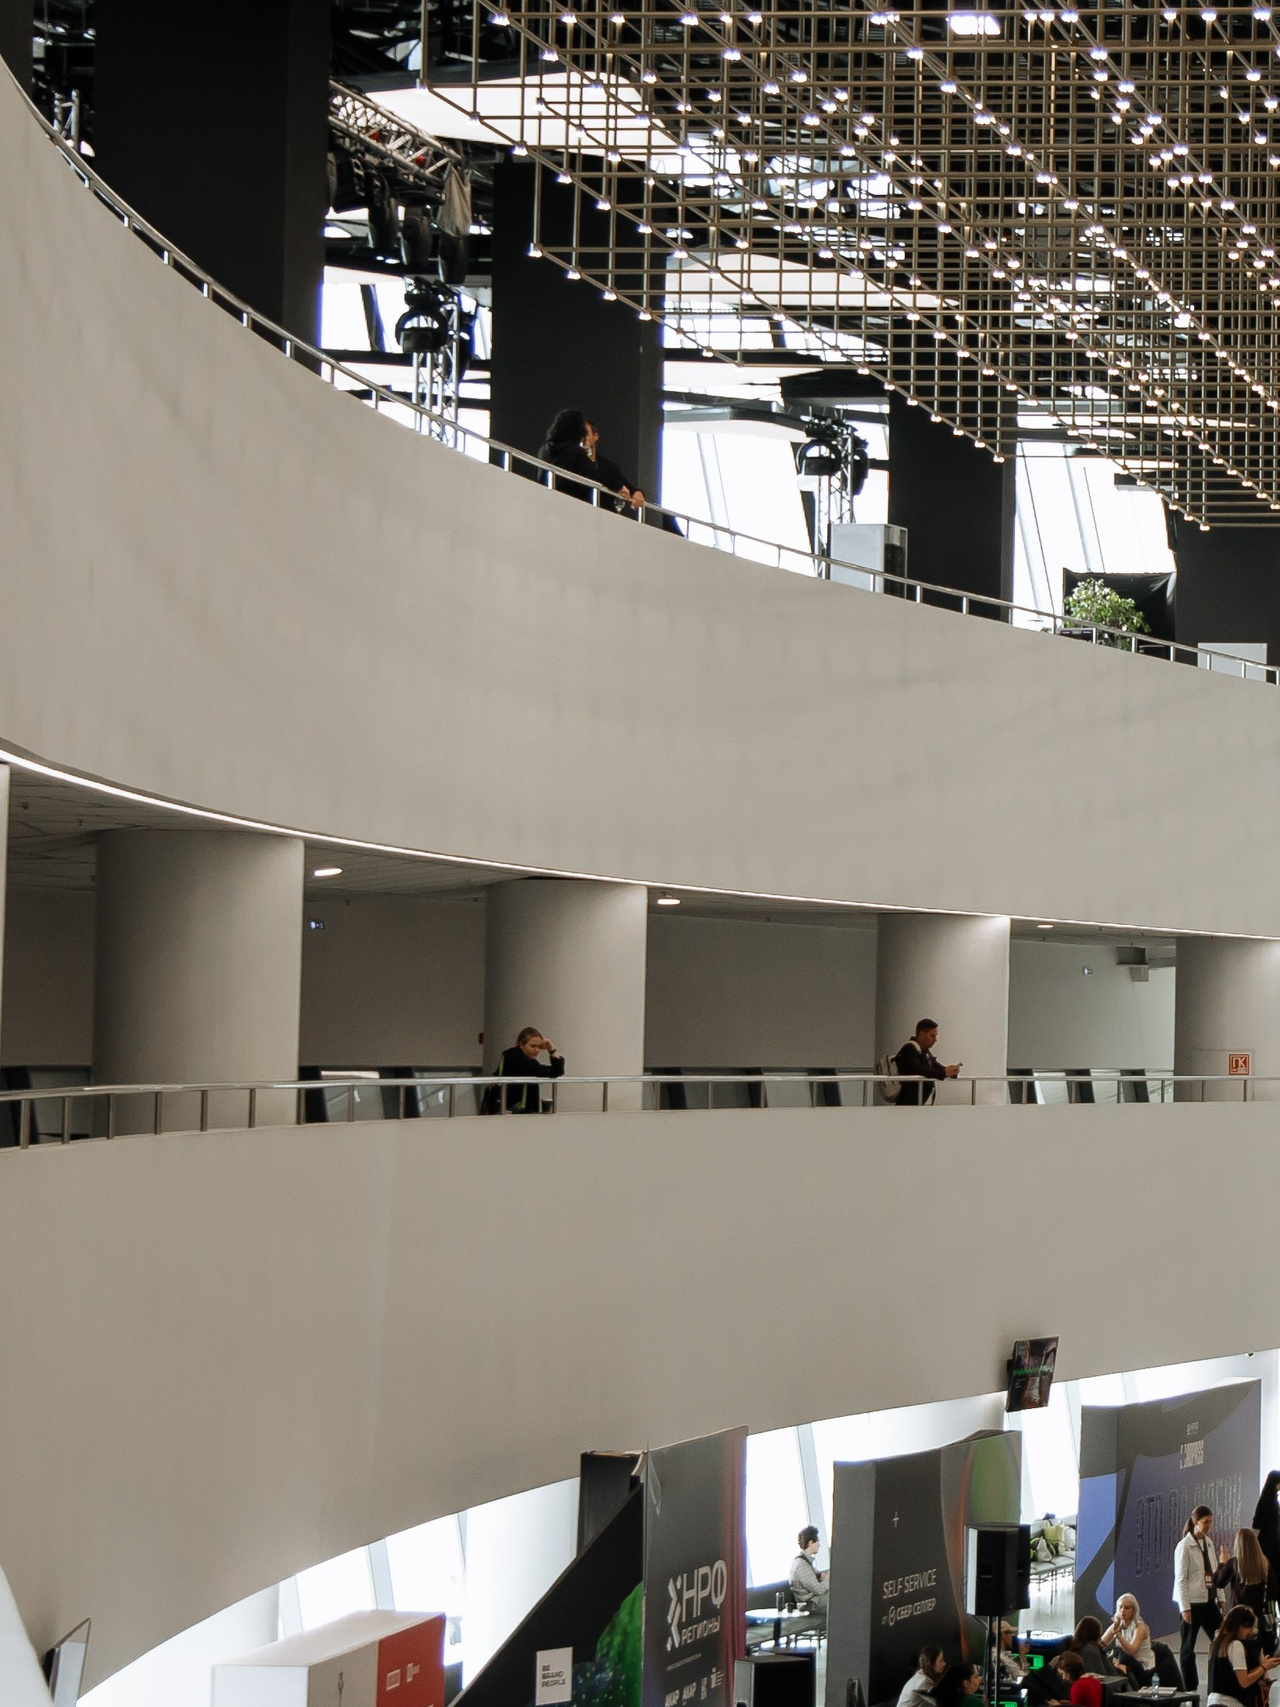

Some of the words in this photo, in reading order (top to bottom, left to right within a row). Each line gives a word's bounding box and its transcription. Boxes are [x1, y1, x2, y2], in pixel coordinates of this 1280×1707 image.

[1232, 1057, 1246, 1068] ПК
[683, 1559, 727, 1623] НРФ
[883, 1578, 903, 1599] SELF
[904, 1568, 937, 1593] SERVICE
[681, 1615, 721, 1646] РЕГИОНЫ
